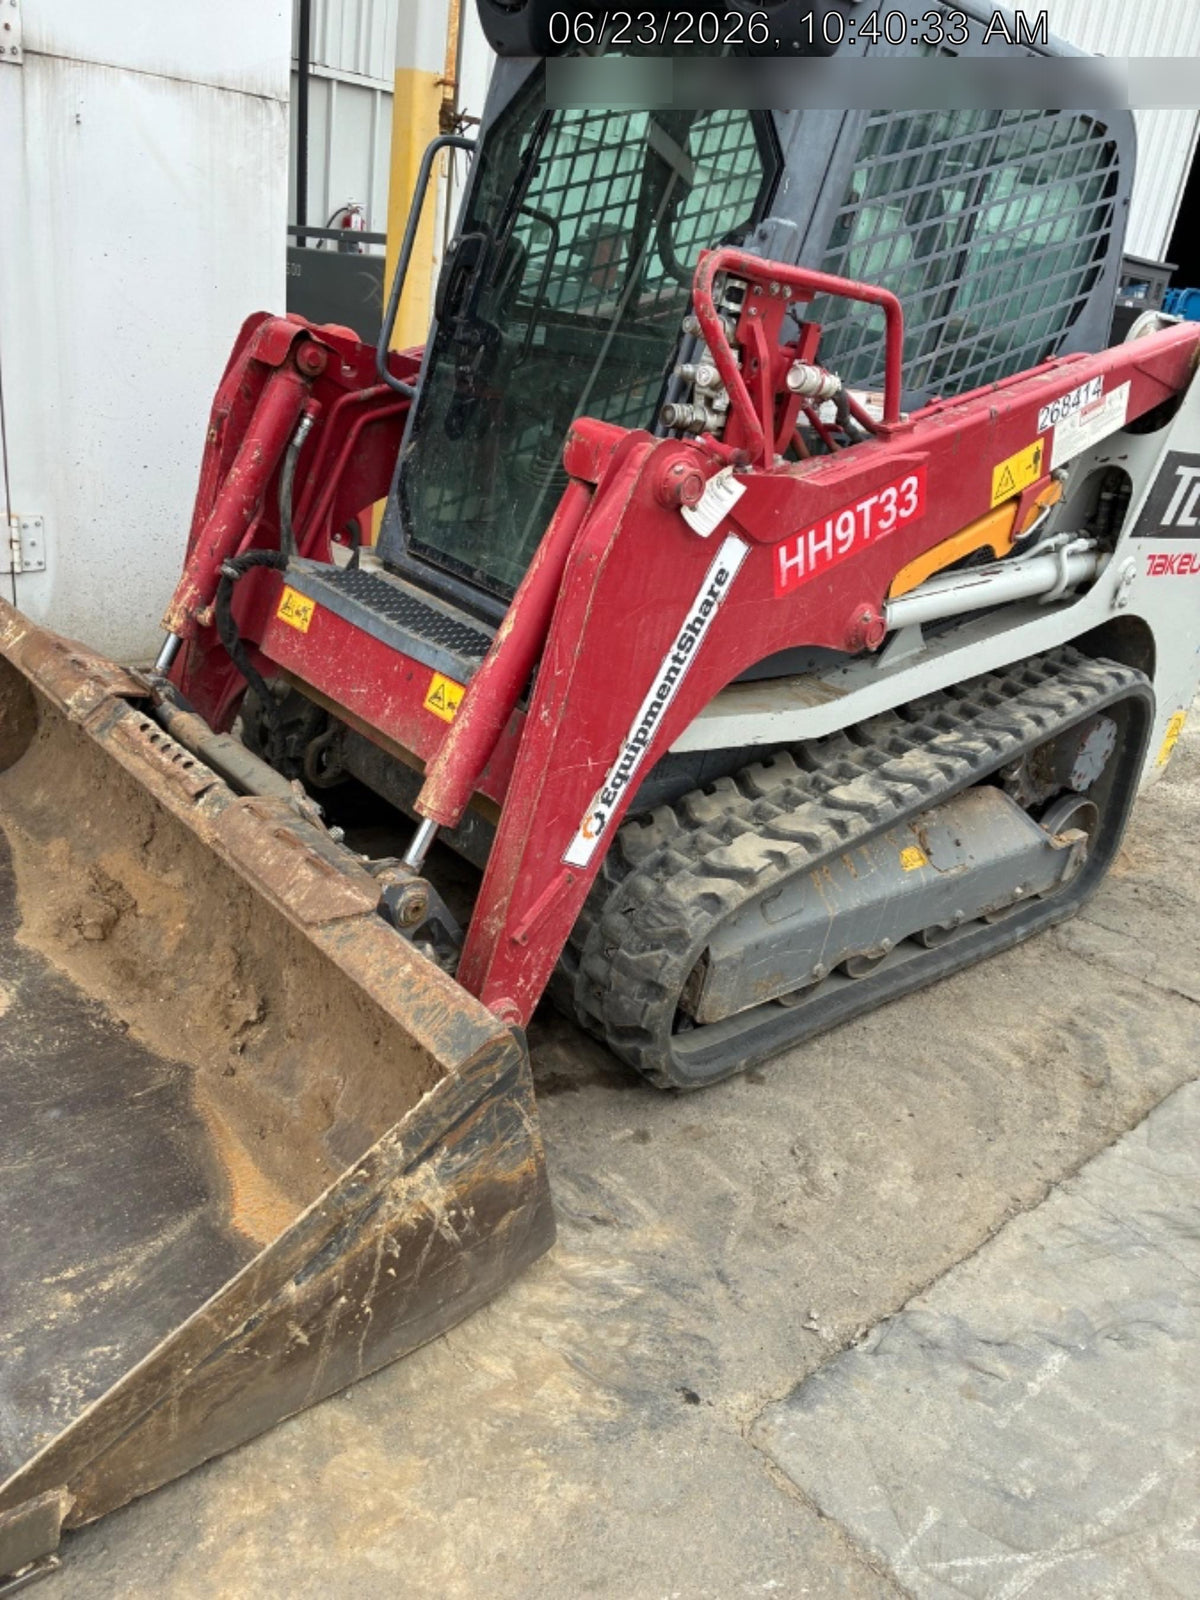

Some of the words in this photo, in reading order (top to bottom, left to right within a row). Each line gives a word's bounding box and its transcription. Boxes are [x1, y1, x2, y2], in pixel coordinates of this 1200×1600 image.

[1039, 375, 1102, 431] 268414
[778, 476, 918, 587] HH9T33
[1160, 465, 1200, 526] TL
[600, 567, 730, 808] EquipmentShare
